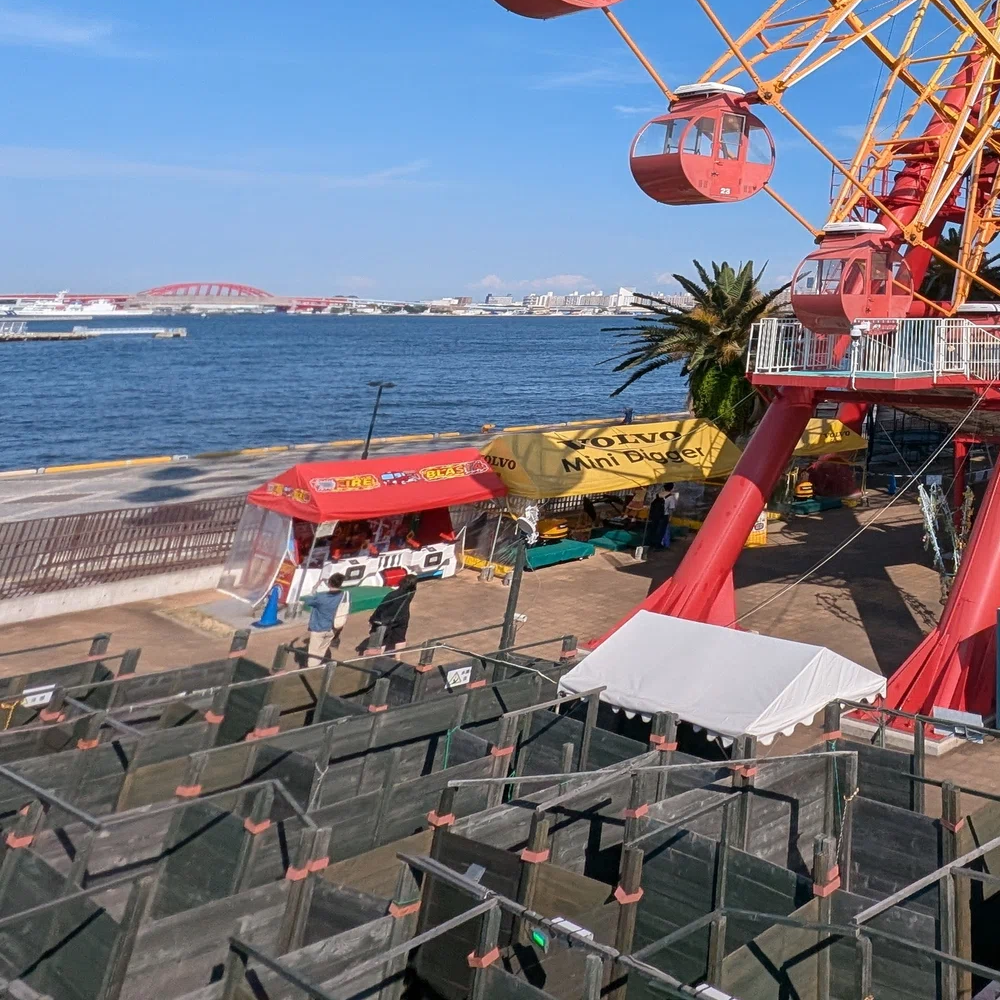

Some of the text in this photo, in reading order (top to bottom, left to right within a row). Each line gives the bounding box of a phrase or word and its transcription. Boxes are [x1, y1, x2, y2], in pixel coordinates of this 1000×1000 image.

[720, 187, 731, 195] 23
[557, 431, 682, 450] VOLVO
[481, 455, 517, 470] OLVO
[561, 447, 705, 473] Mini Digger
